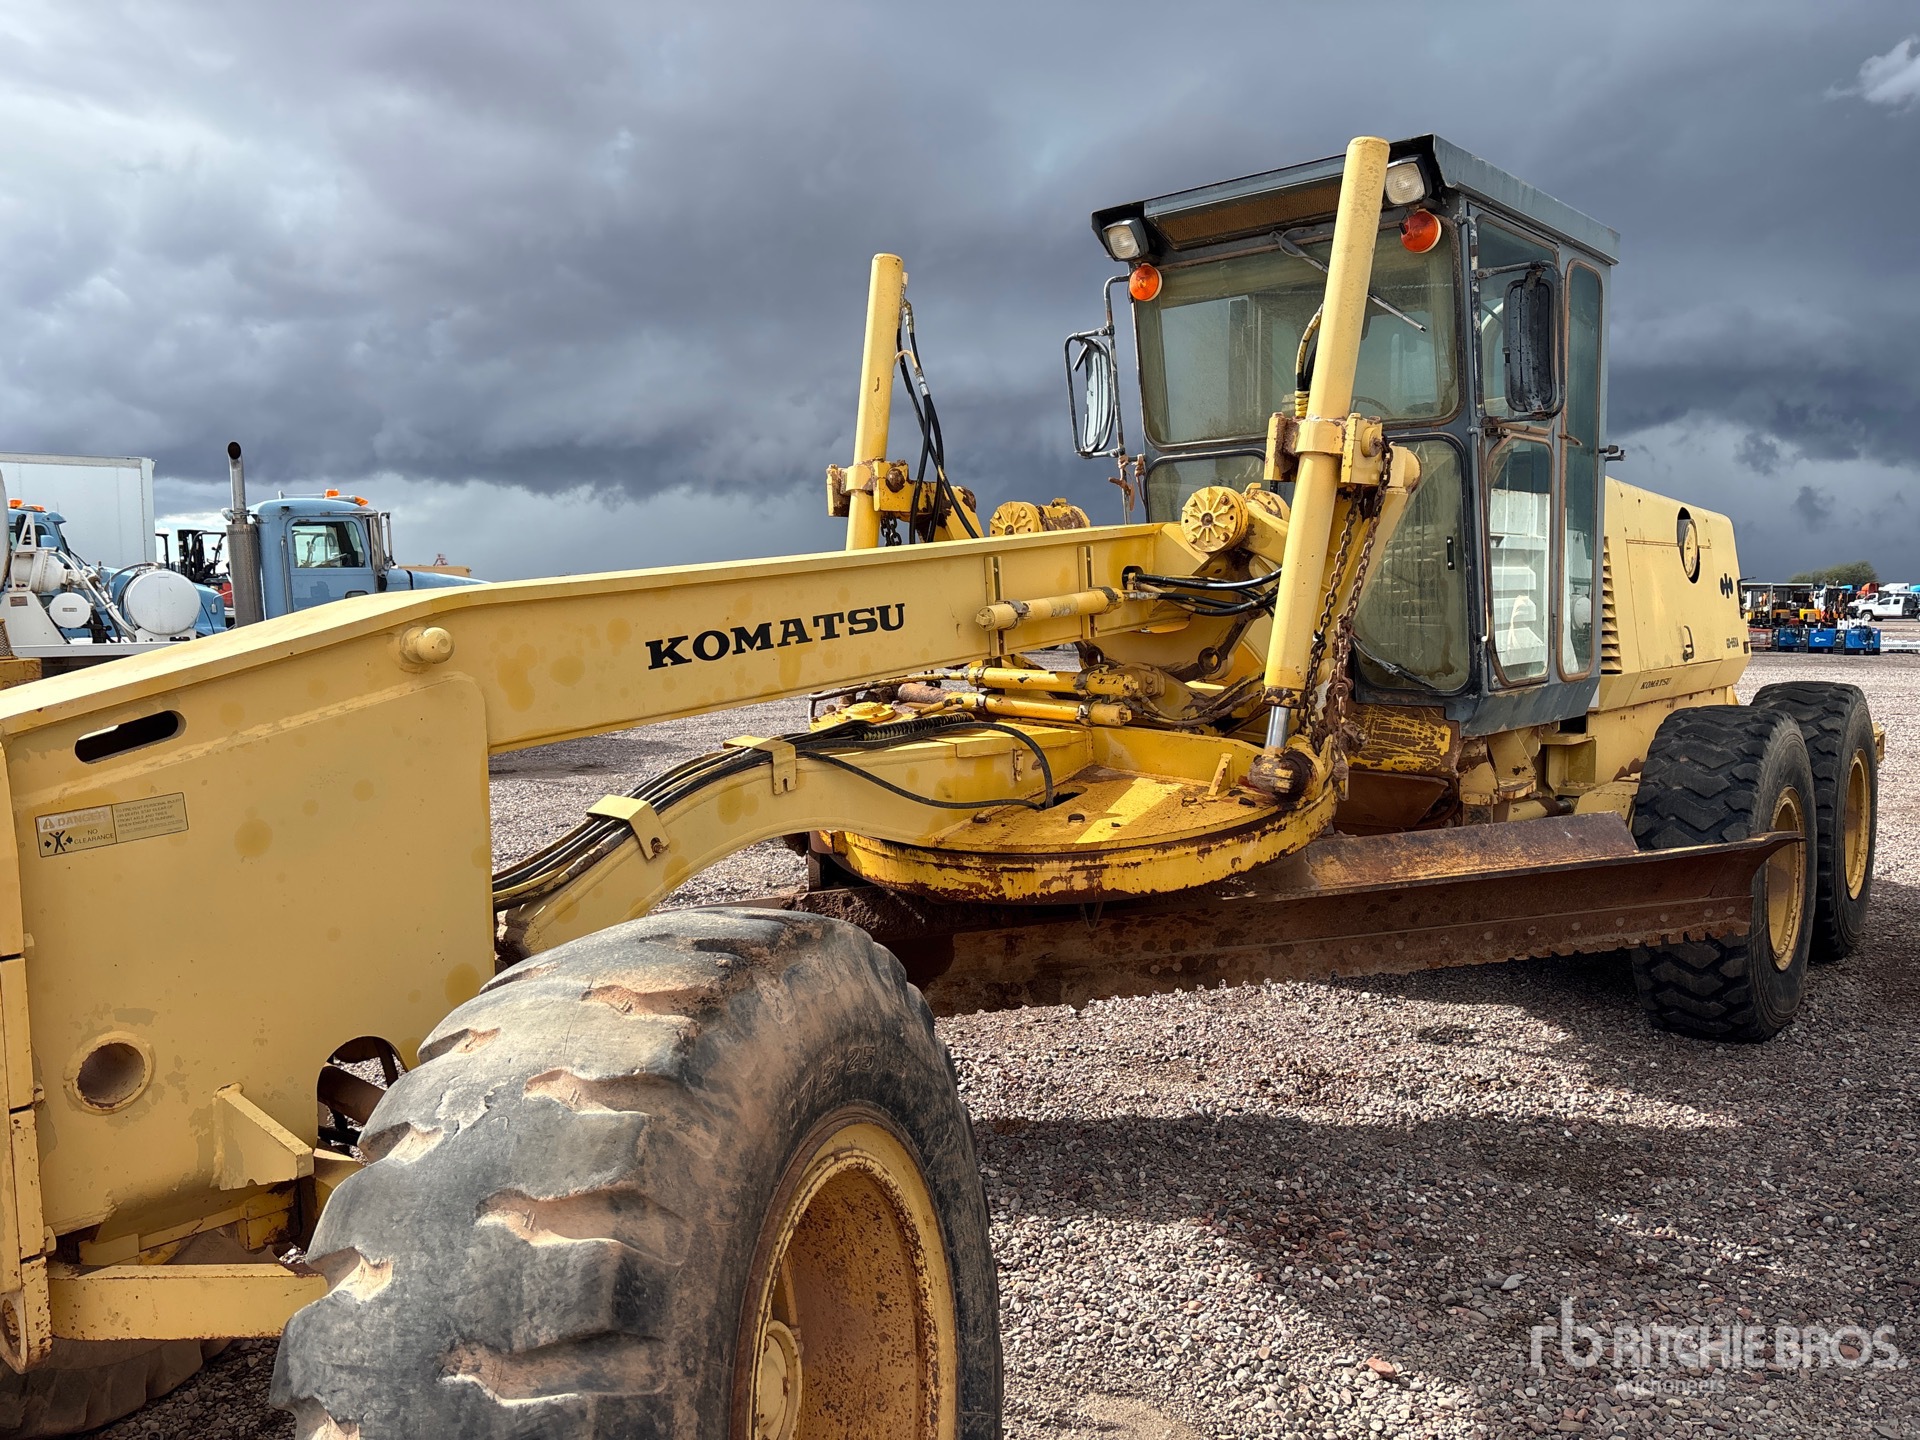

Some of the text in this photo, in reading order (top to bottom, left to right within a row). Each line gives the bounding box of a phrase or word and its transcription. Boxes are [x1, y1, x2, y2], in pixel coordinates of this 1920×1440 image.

[645, 603, 905, 670] KOMATSU
[1640, 677, 1672, 690] KOMATSU
[57, 810, 106, 827] DANGER
[74, 832, 115, 845] CLEARANCE
[87, 828, 98, 836] NO
